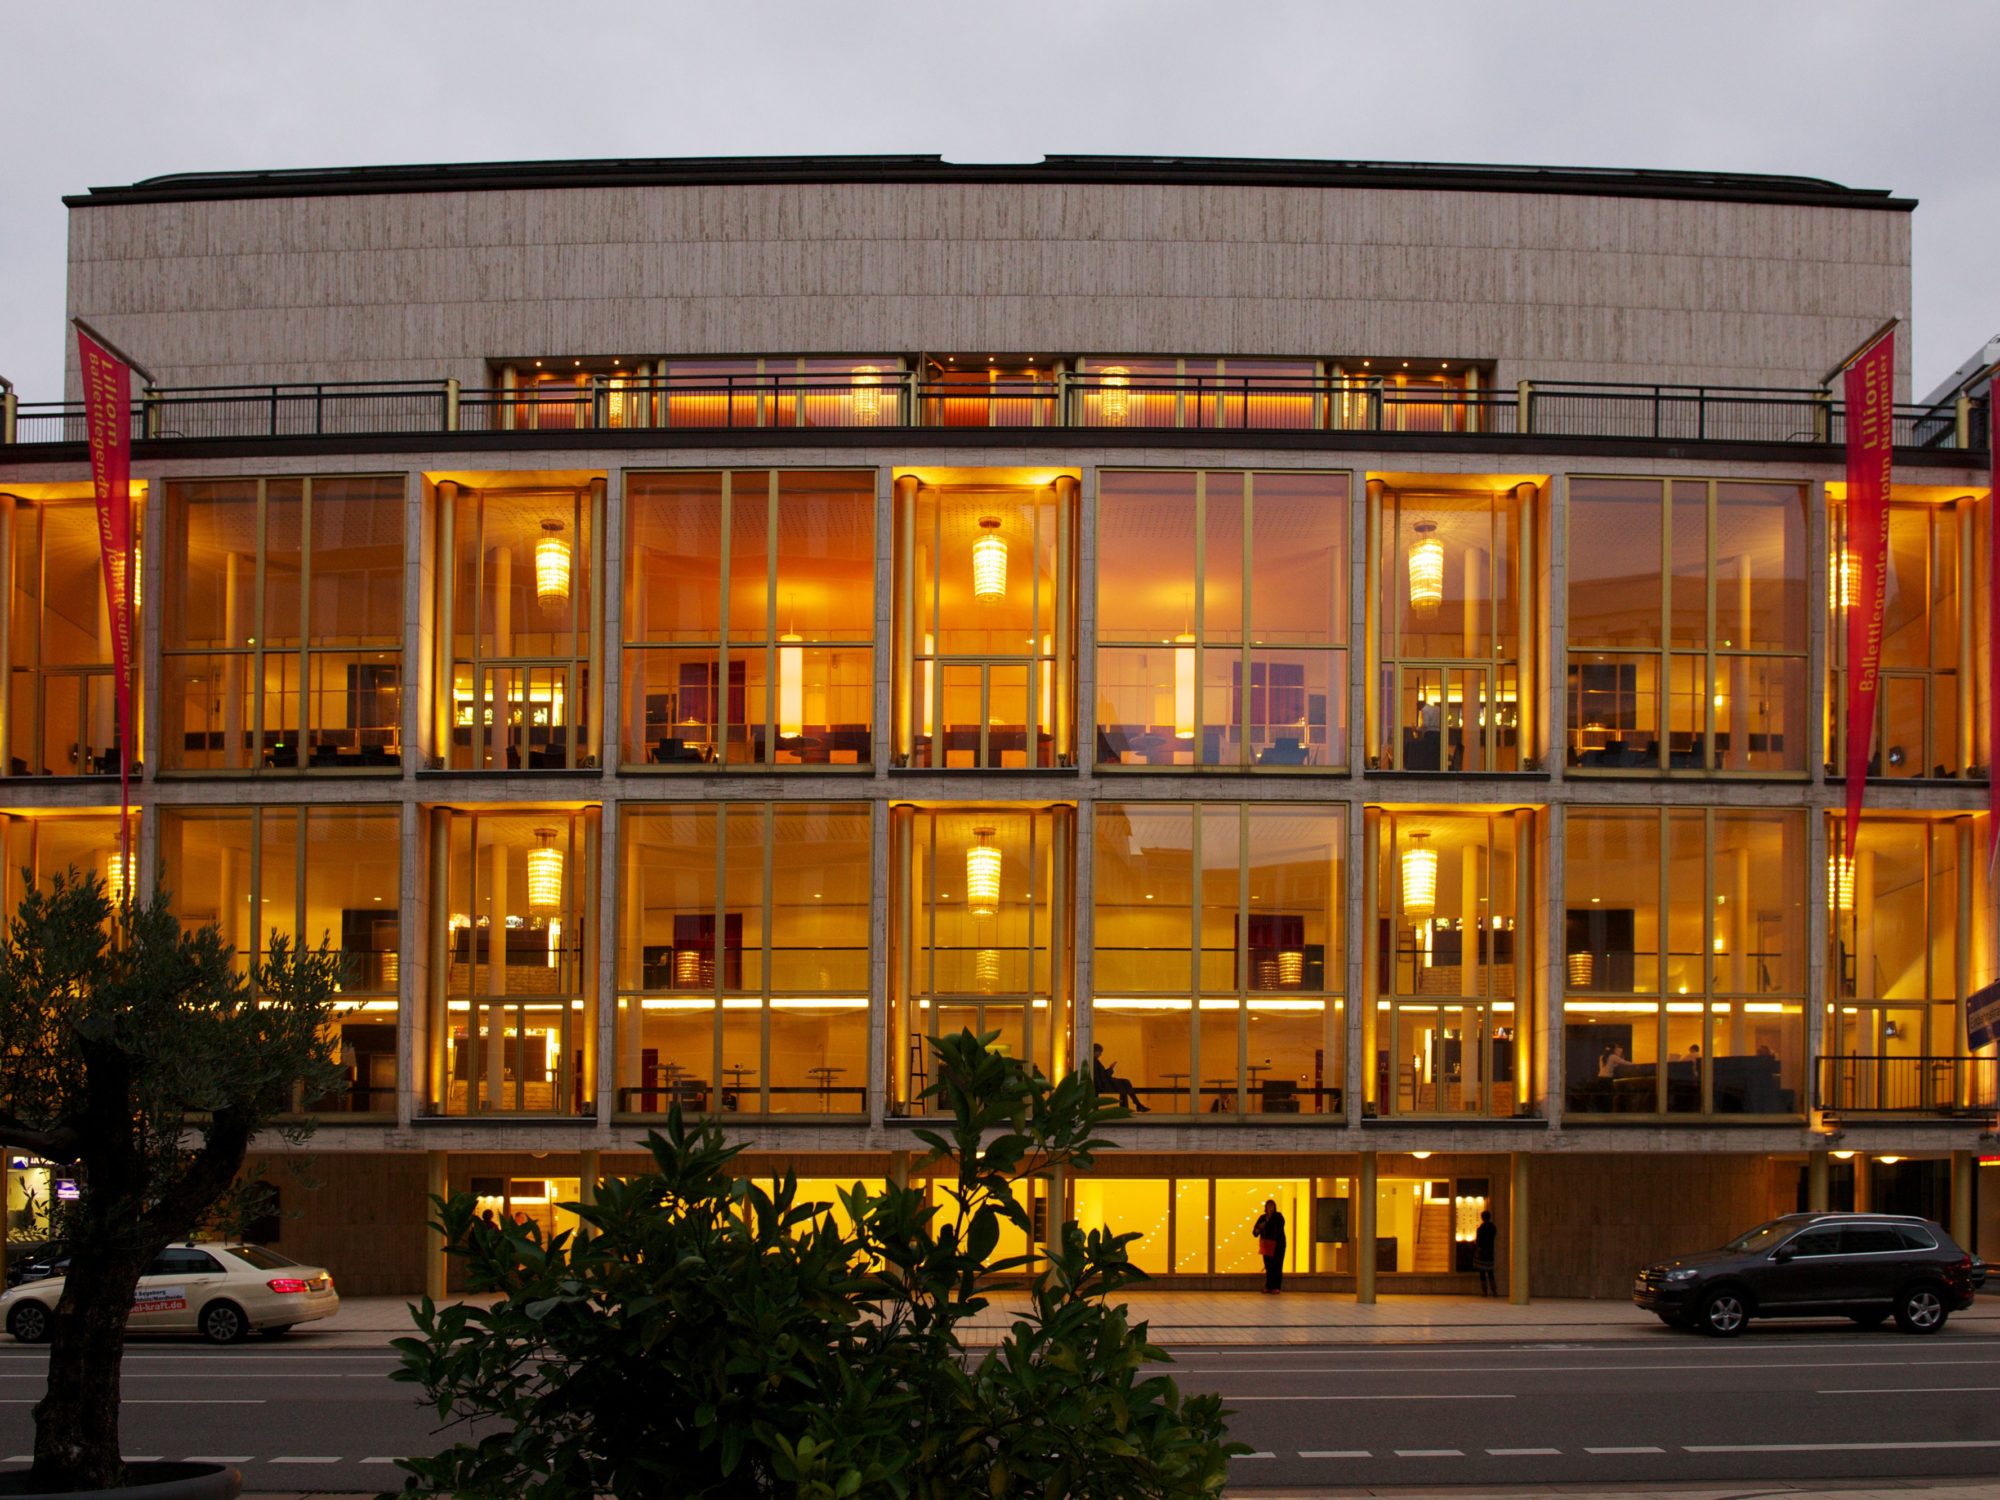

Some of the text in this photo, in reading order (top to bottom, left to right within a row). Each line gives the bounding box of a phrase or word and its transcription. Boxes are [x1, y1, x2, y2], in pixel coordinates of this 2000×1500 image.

[101, 359, 117, 447] Liliom
[1862, 360, 1878, 449] Liliom
[1879, 354, 1891, 450] Neumeier
[89, 352, 110, 498] Ballettlegende
[100, 506, 113, 541] von
[117, 600, 131, 689] Neumeier
[1880, 508, 1889, 542] von
[1858, 551, 1887, 691] Ballettlegende
